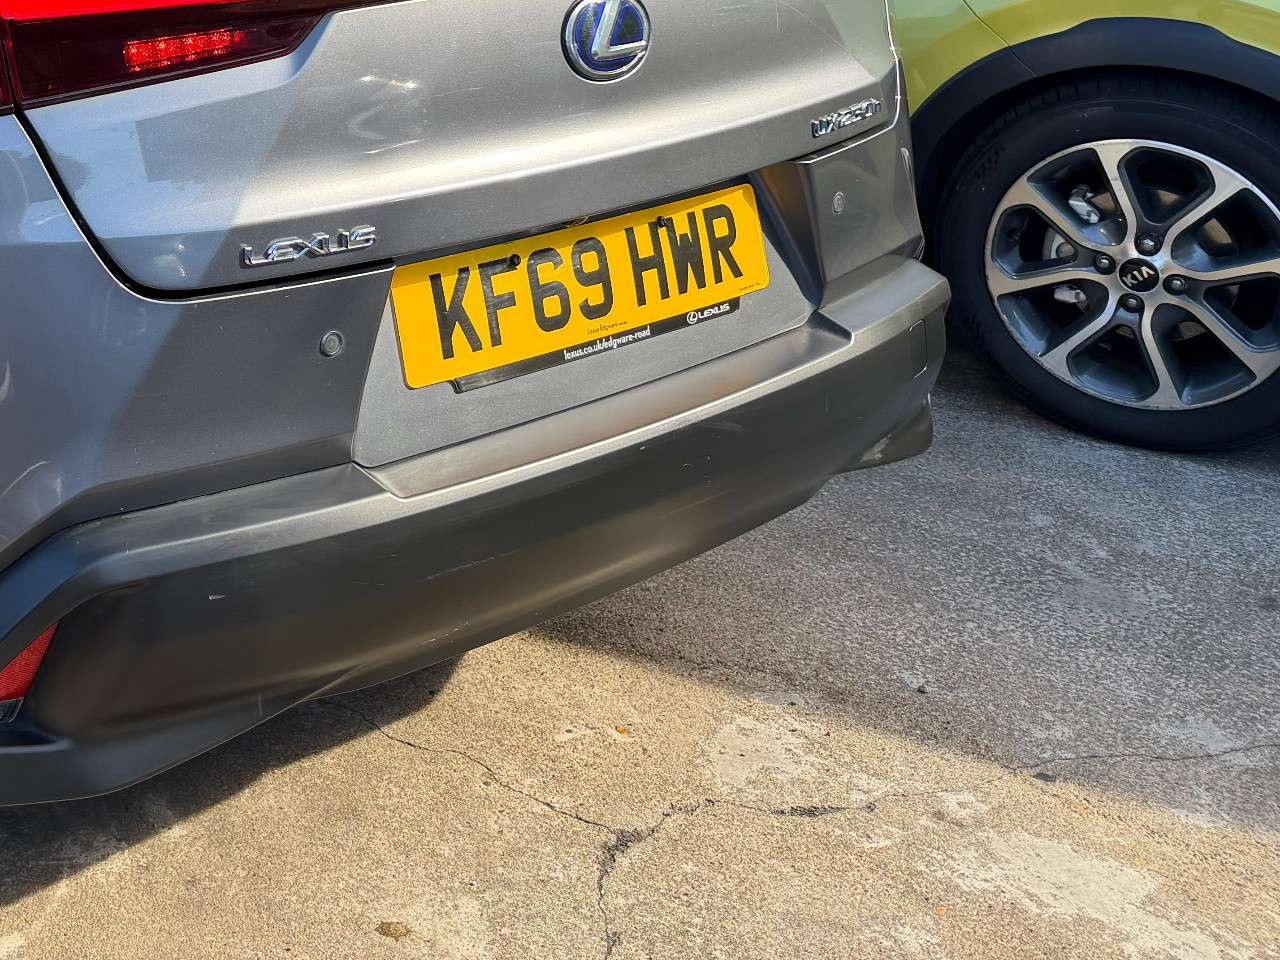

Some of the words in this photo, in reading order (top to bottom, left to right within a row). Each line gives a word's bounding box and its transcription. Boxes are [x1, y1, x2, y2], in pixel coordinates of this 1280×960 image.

[239, 224, 377, 269] LEXUS
[429, 236, 615, 360] KF69
[624, 203, 744, 308] HWR
[1122, 266, 1155, 286] KIA
[698, 302, 730, 319] LEXUS
[563, 324, 651, 361] lexus.co.uk/edgware-road
